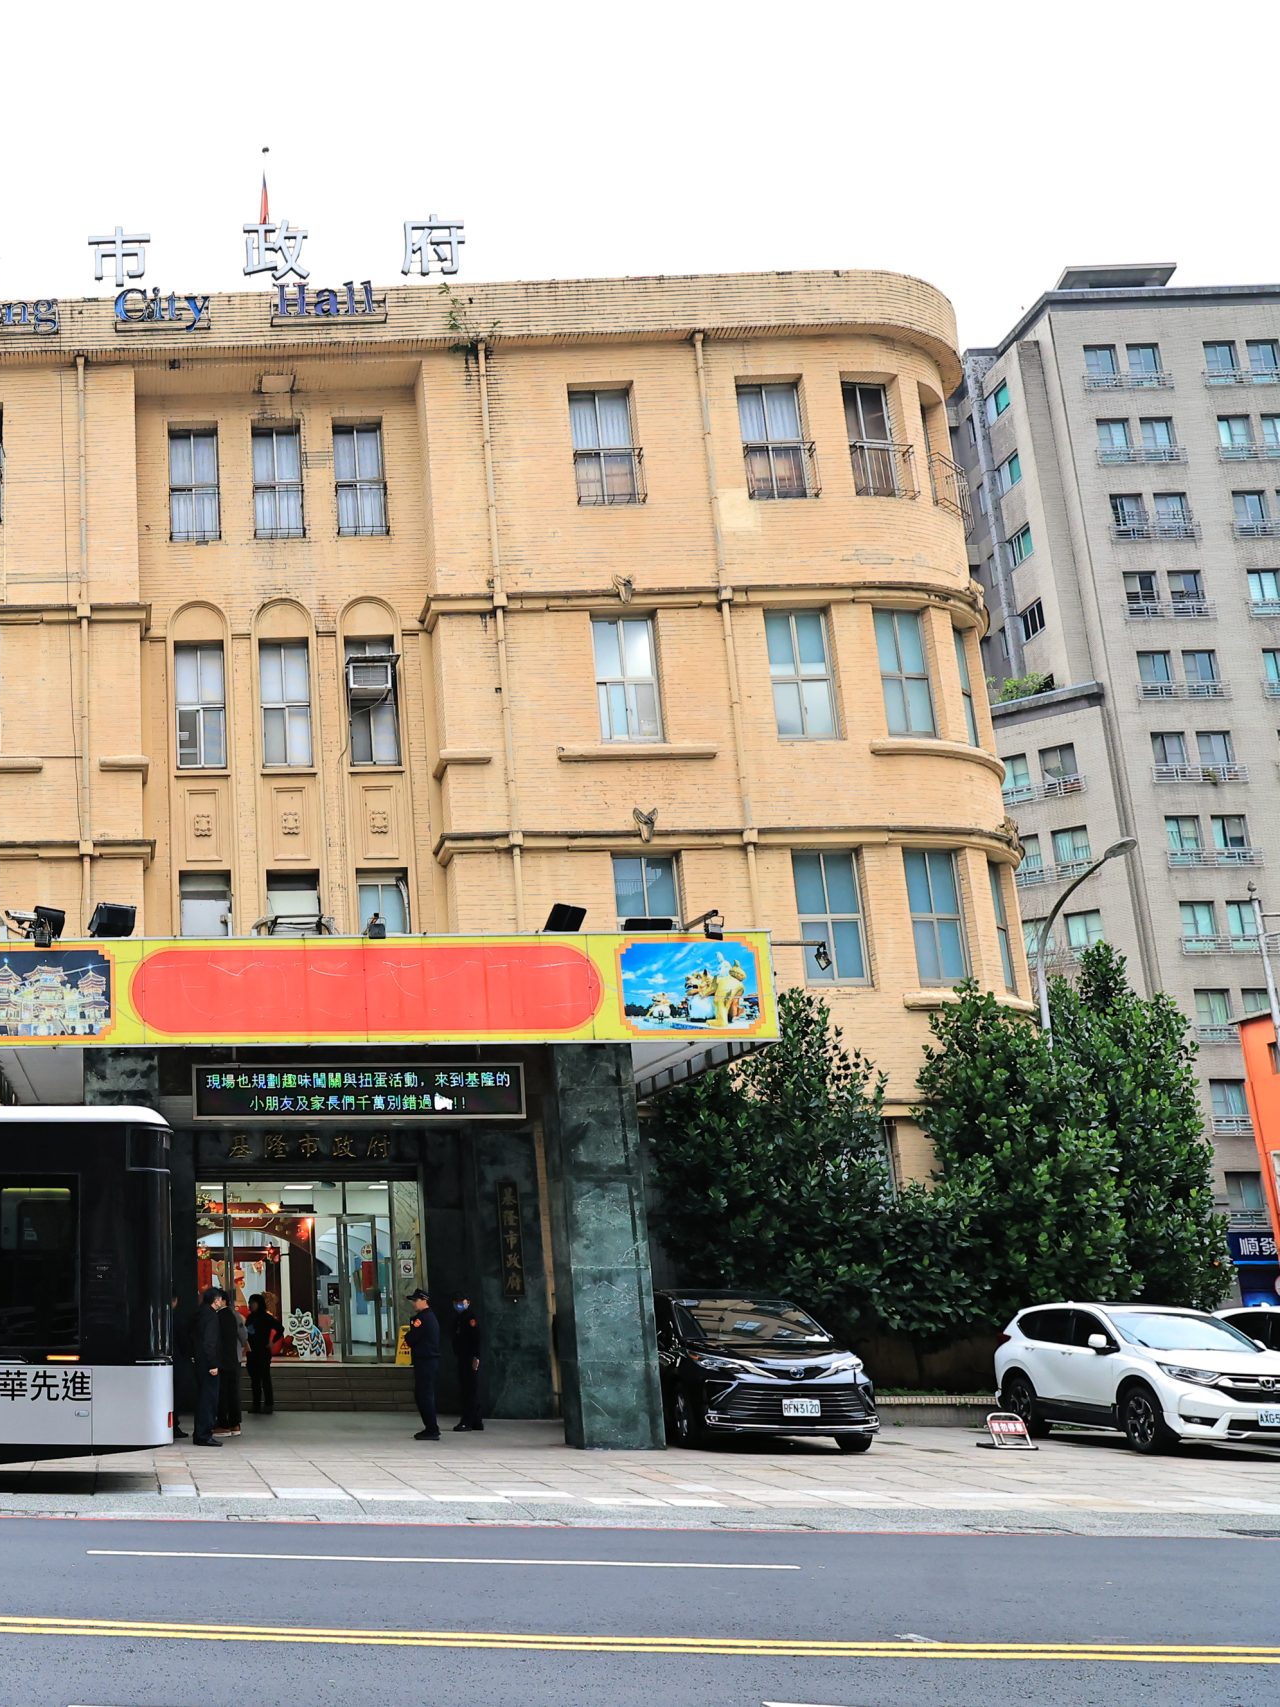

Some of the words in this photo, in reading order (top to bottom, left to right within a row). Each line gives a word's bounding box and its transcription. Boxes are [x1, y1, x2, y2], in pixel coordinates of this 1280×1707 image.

[116, 286, 210, 330] City
[273, 281, 374, 317] Hall
[228, 1134, 391, 1159] 基隆市政府
[502, 1186, 522, 1291] 基隆市政府
